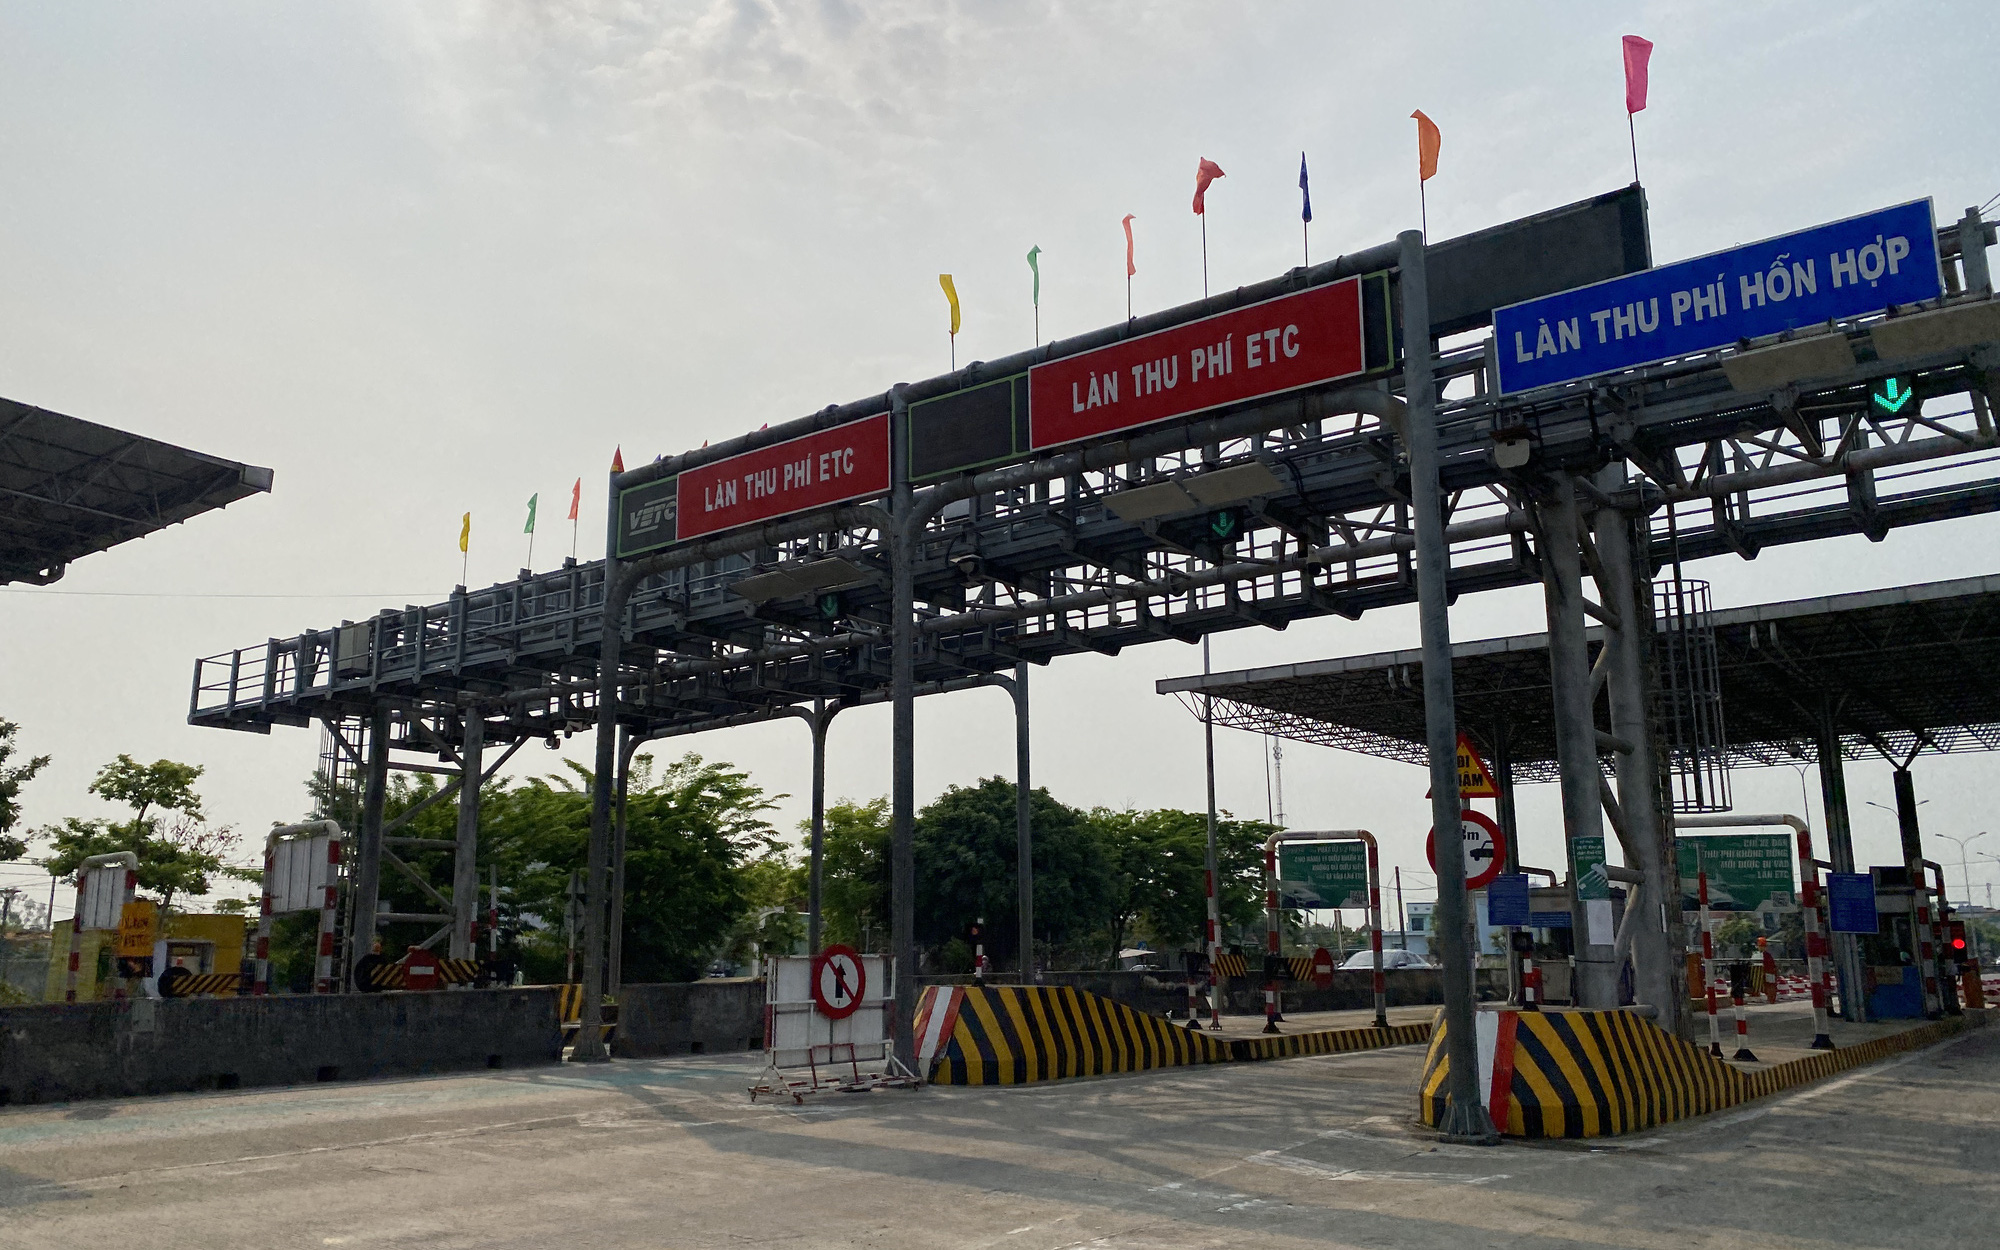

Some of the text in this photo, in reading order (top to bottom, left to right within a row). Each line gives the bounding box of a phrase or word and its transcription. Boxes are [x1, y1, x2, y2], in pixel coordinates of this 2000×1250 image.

[1514, 234, 1911, 364] LÀN THU PHÍ HỖN HỢP
[1072, 324, 1300, 413] LÀN THU PHÍ ETC
[704, 447, 854, 512] LÀN THU PHÍ ETC
